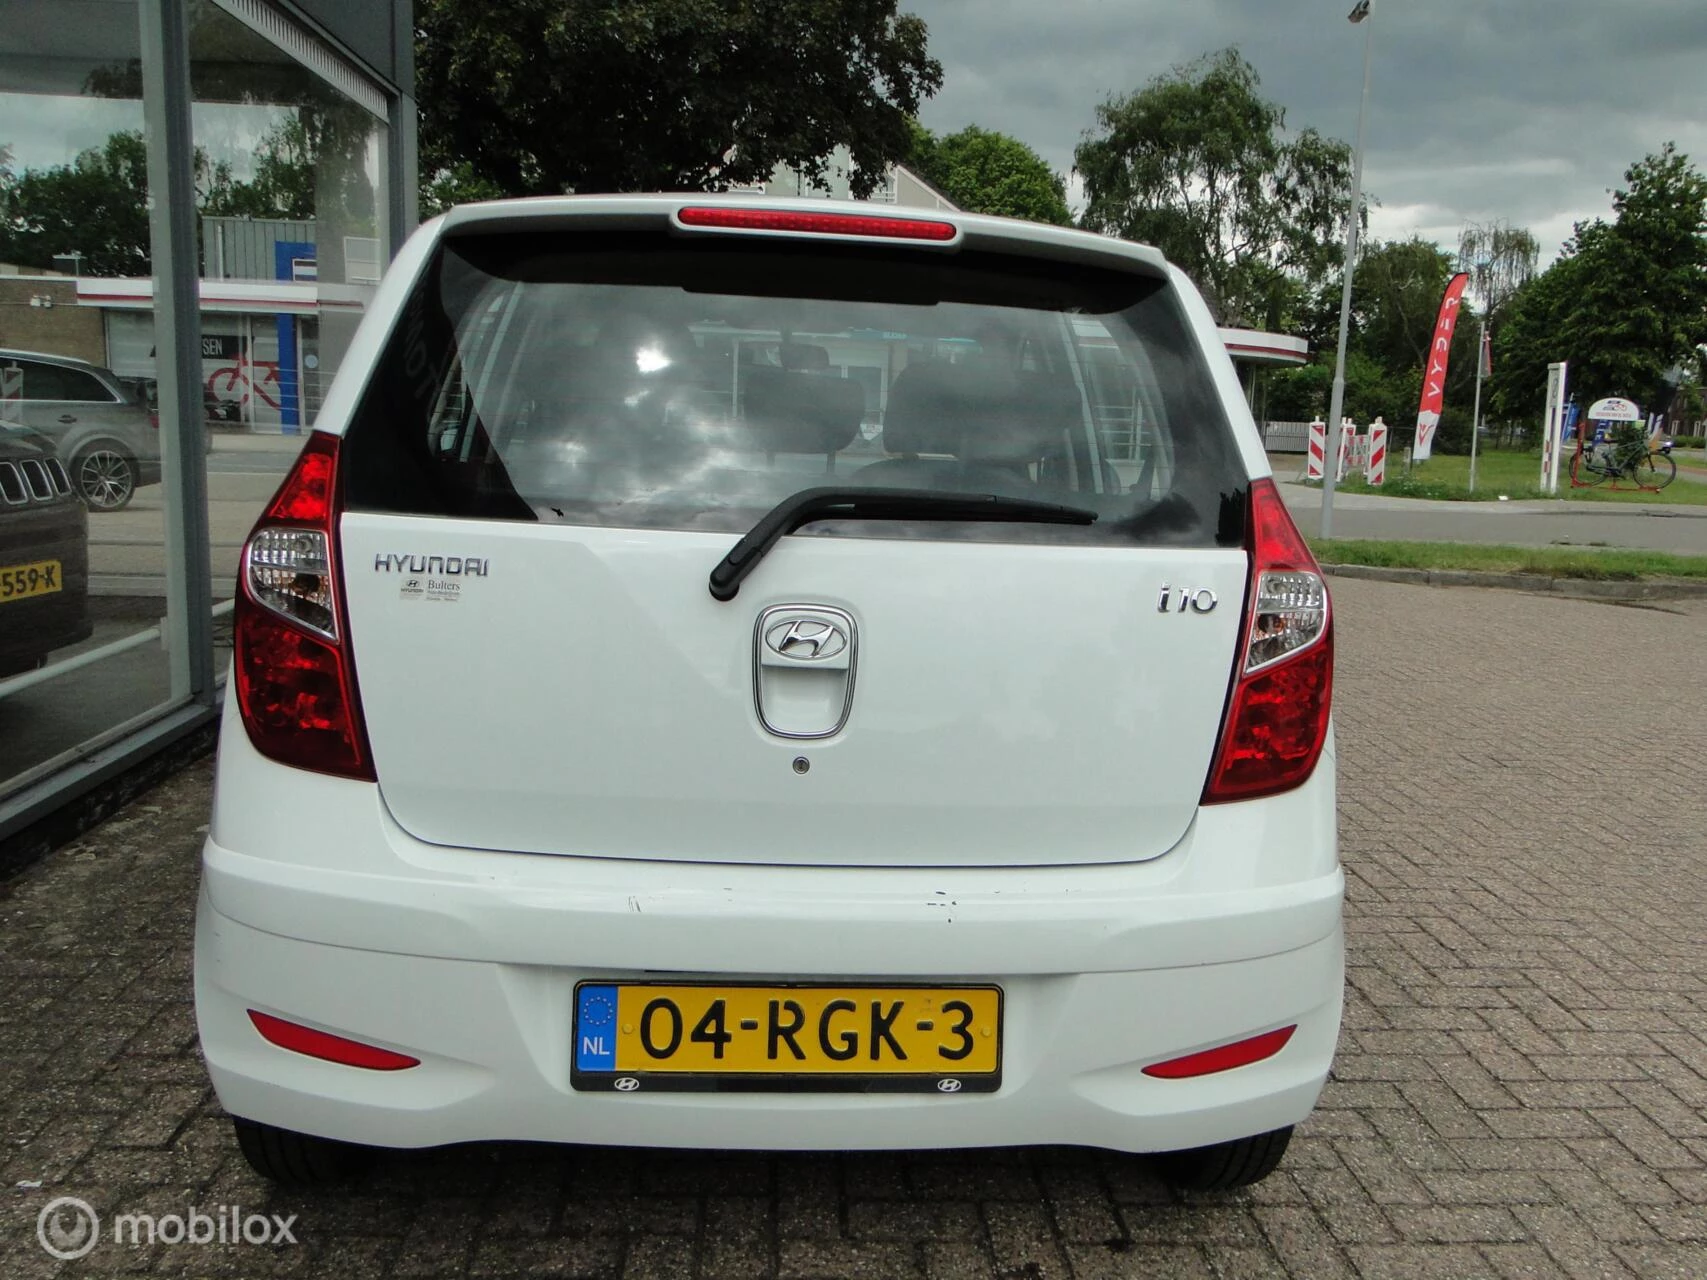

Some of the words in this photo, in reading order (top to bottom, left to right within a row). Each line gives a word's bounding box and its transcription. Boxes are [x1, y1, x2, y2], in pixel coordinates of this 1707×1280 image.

[374, 553, 489, 577] HYUNDAI
[1158, 582, 1218, 614] i10
[639, 997, 975, 1061] 04-RGK-3
[583, 1036, 610, 1056] NL
